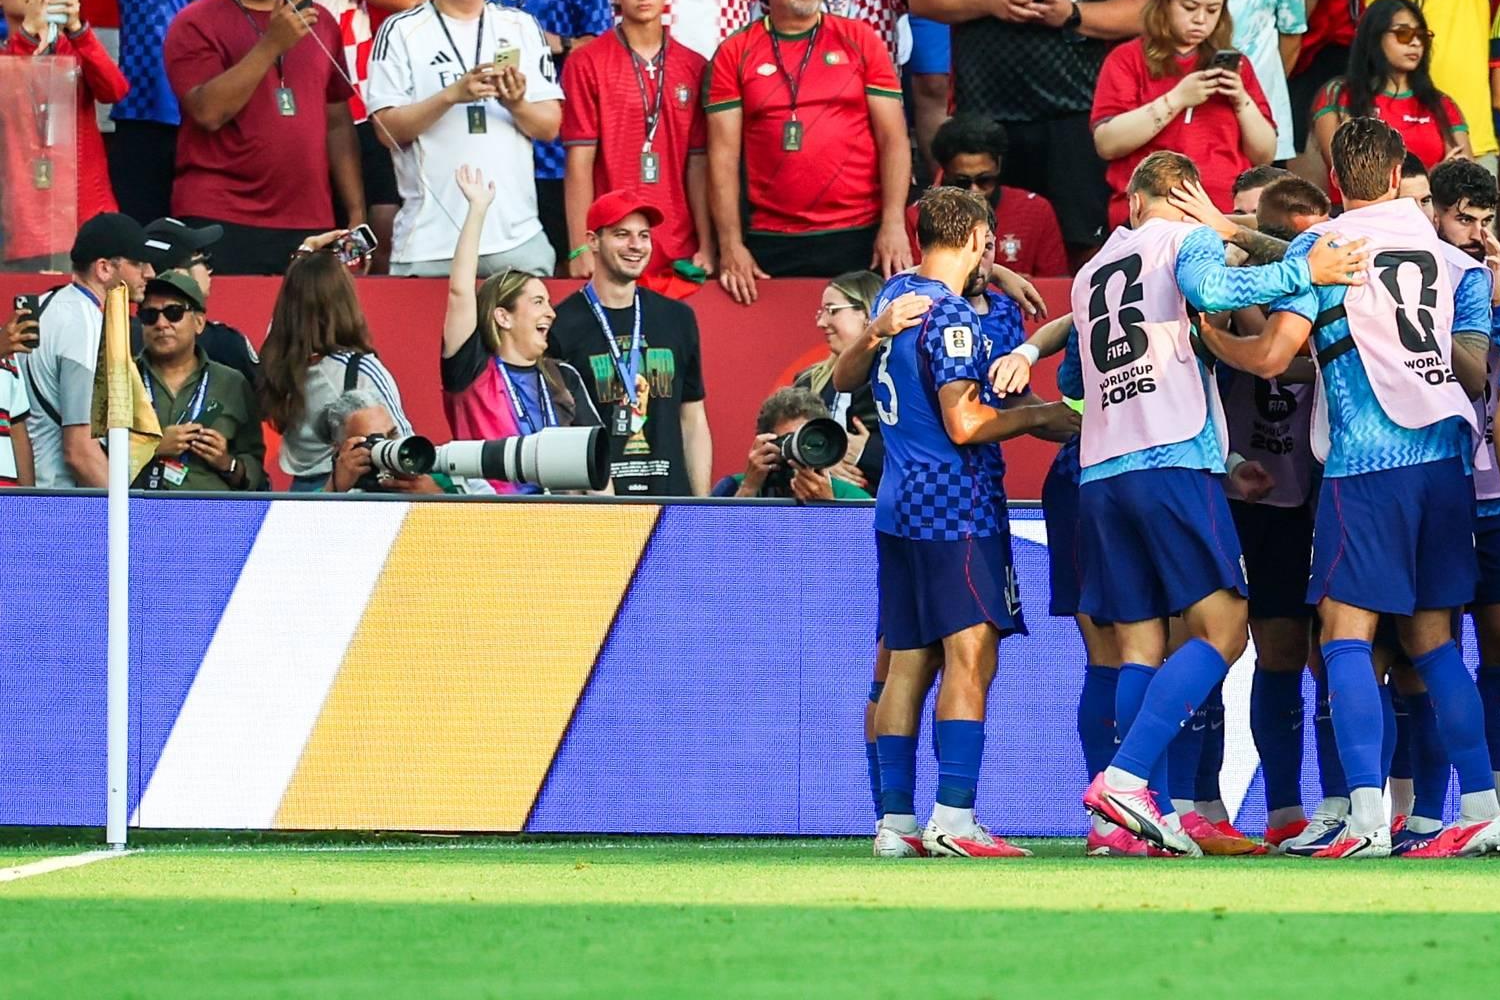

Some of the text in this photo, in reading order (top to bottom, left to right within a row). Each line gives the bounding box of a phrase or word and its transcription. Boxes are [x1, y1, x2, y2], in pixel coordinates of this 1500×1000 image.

[1106, 340, 1132, 362] FIFA
[1128, 364, 1153, 381] CUP
[1101, 377, 1157, 411] 2026
